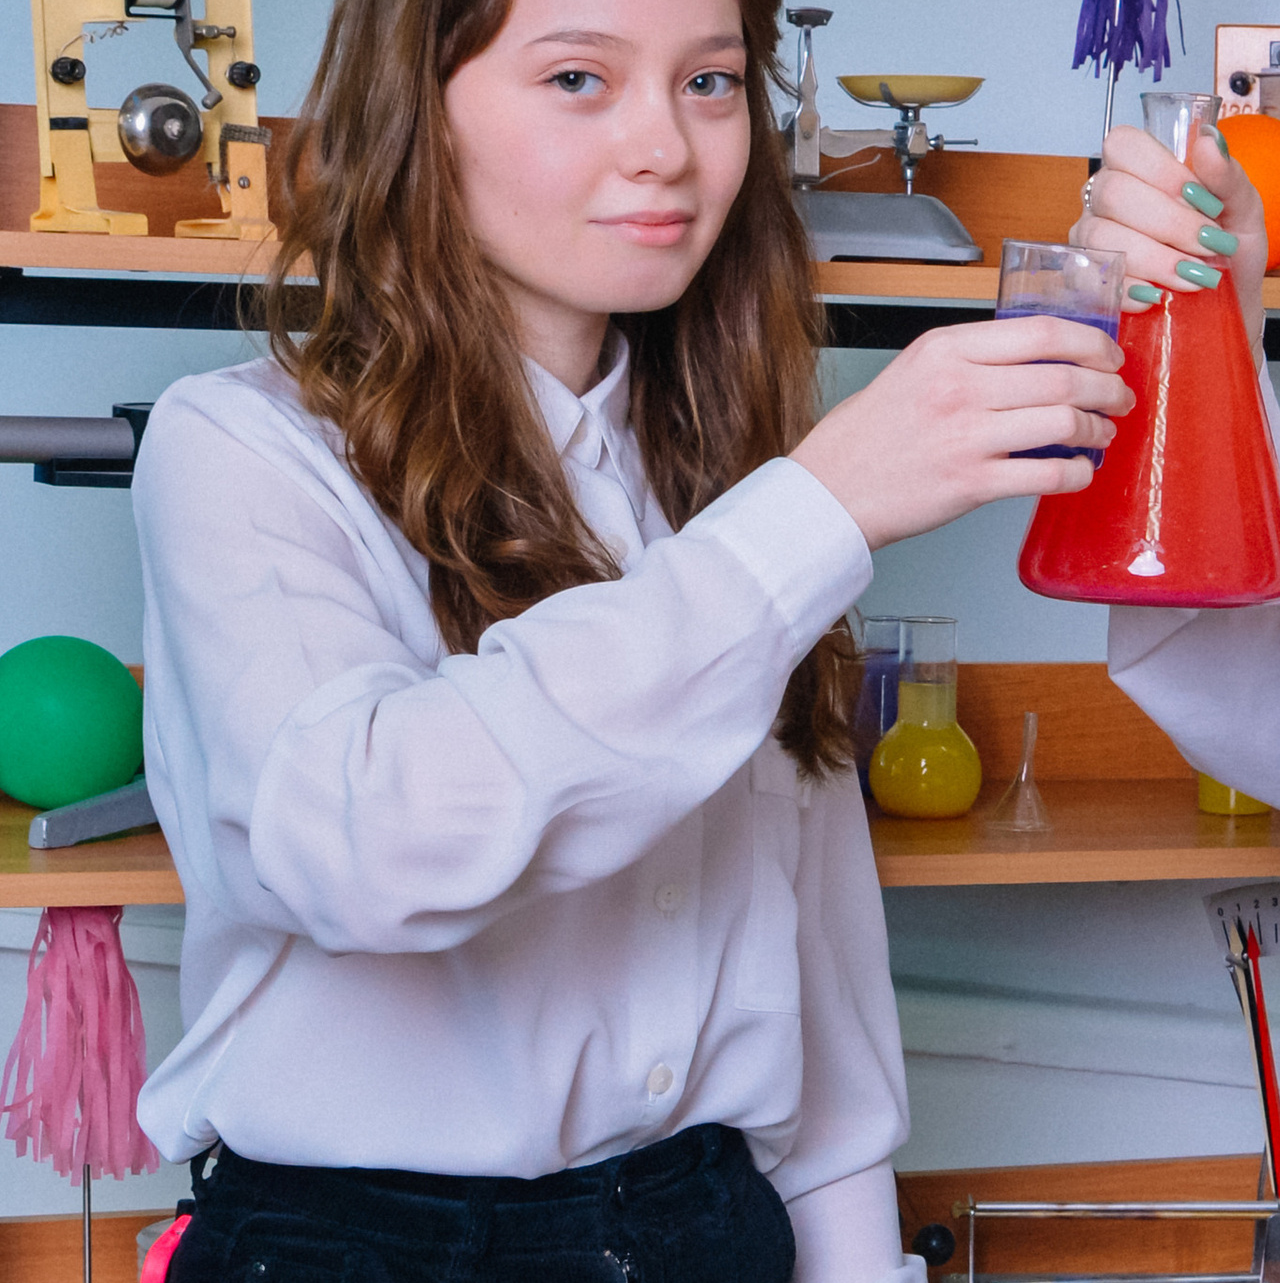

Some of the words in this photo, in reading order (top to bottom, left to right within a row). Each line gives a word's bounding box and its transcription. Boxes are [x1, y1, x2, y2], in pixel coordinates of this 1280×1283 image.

[1217, 906, 1224, 917] 0
[1253, 898, 1260, 909] 2
[1272, 896, 1279, 907] 3
